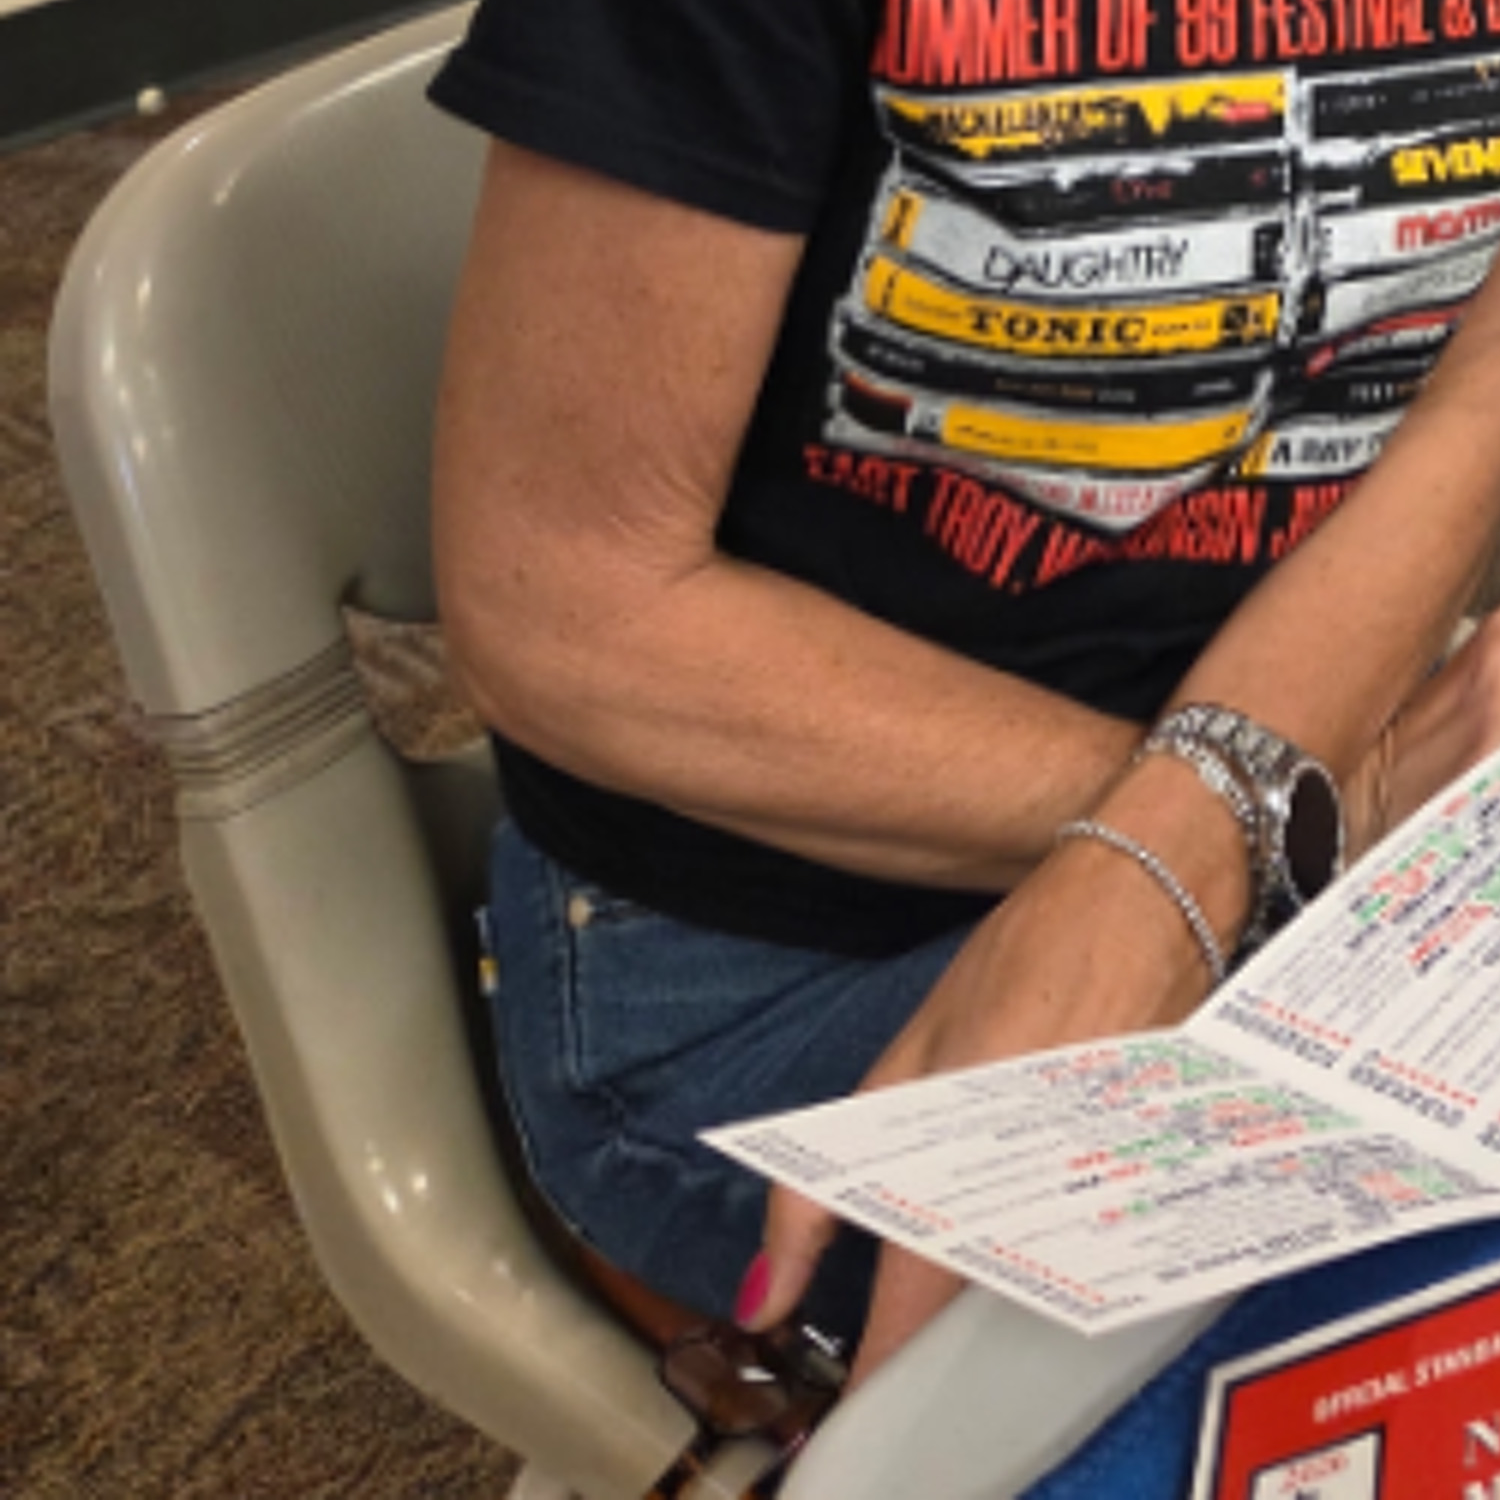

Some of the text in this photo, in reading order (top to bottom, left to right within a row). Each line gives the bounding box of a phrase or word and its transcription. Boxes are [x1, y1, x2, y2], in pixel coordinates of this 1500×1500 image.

[983, 235, 1190, 294] DAUGHTRY
[966, 302, 1148, 345] TONIC
[1312, 1370, 1409, 1424] OFFICIAL
